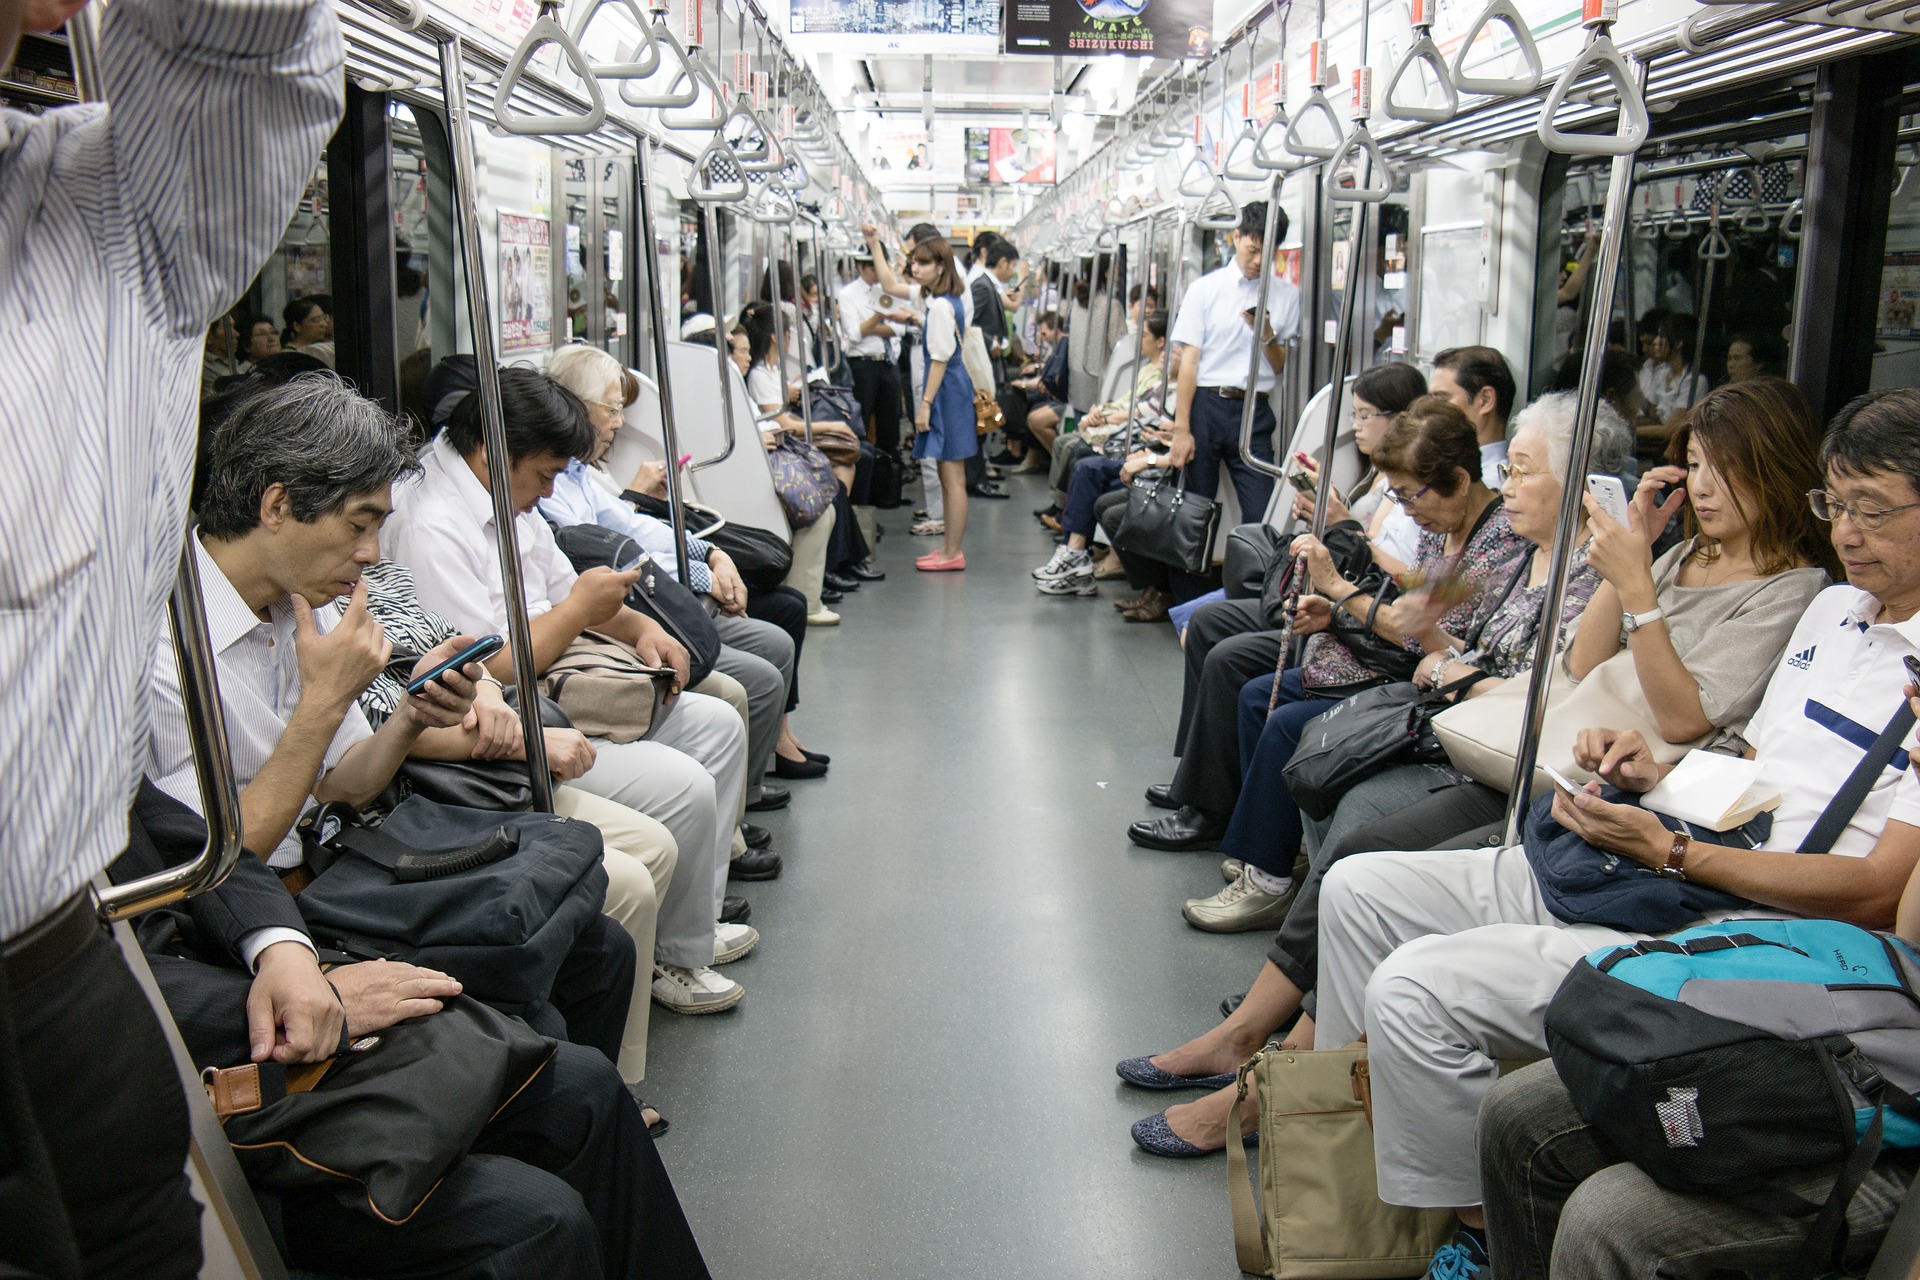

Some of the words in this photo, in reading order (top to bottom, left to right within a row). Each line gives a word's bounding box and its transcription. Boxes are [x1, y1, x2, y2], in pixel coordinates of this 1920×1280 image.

[1083, 15, 1142, 32] IWATE
[1069, 39, 1153, 49] SHIZUKUISHI
[1787, 658, 1810, 670] adida
